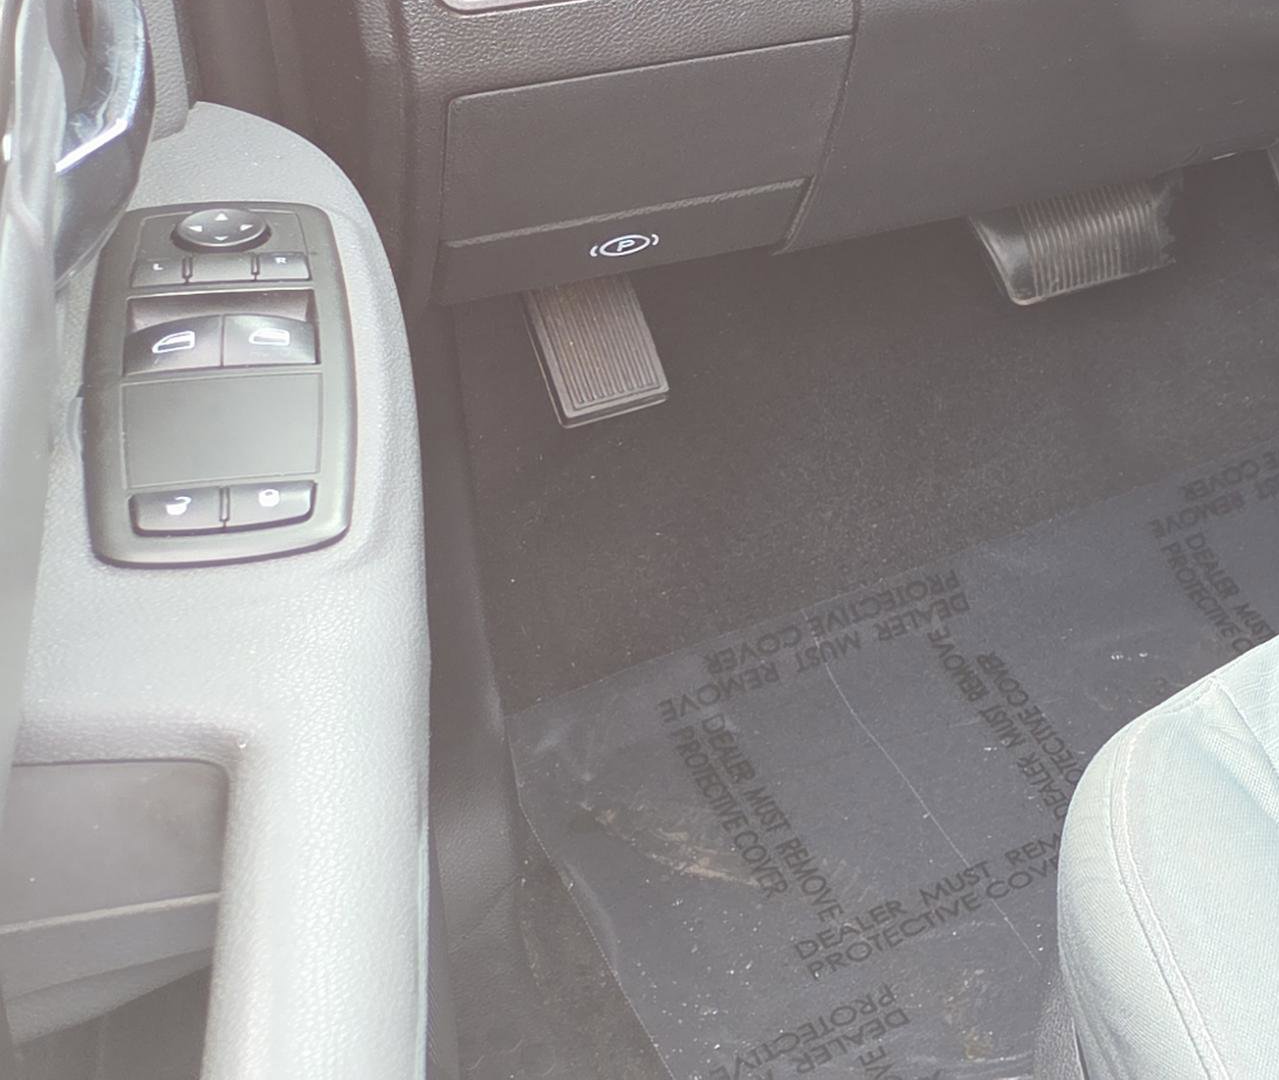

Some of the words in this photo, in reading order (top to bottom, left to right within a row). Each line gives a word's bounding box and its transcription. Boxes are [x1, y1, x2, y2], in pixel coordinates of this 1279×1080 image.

[153, 263, 164, 271] L
[275, 256, 287, 265] R
[1182, 459, 1260, 502] COVER
[1185, 533, 1240, 600] DEALER
[806, 570, 960, 637] PROTECTIVE
[873, 591, 970, 642] DEALER
[704, 625, 801, 674] COVER
[797, 631, 861, 673] MUST
[928, 626, 990, 702] REMOVE
[656, 663, 780, 725] REMOVE
[1017, 705, 1083, 786] OTECTIVE
[669, 726, 747, 832] PROTECTIVE
[734, 830, 789, 899] COVER
[702, 713, 756, 784] DEALER
[743, 786, 791, 833] MUST
[775, 836, 845, 922] REMOVE
[795, 900, 906, 961] DEALER
[919, 860, 992, 906] MUST
[1005, 833, 1059, 867] REM
[806, 891, 982, 981] PROTECTIVE
[986, 856, 1058, 900] COVE
[795, 1006, 911, 1074] DEALER
